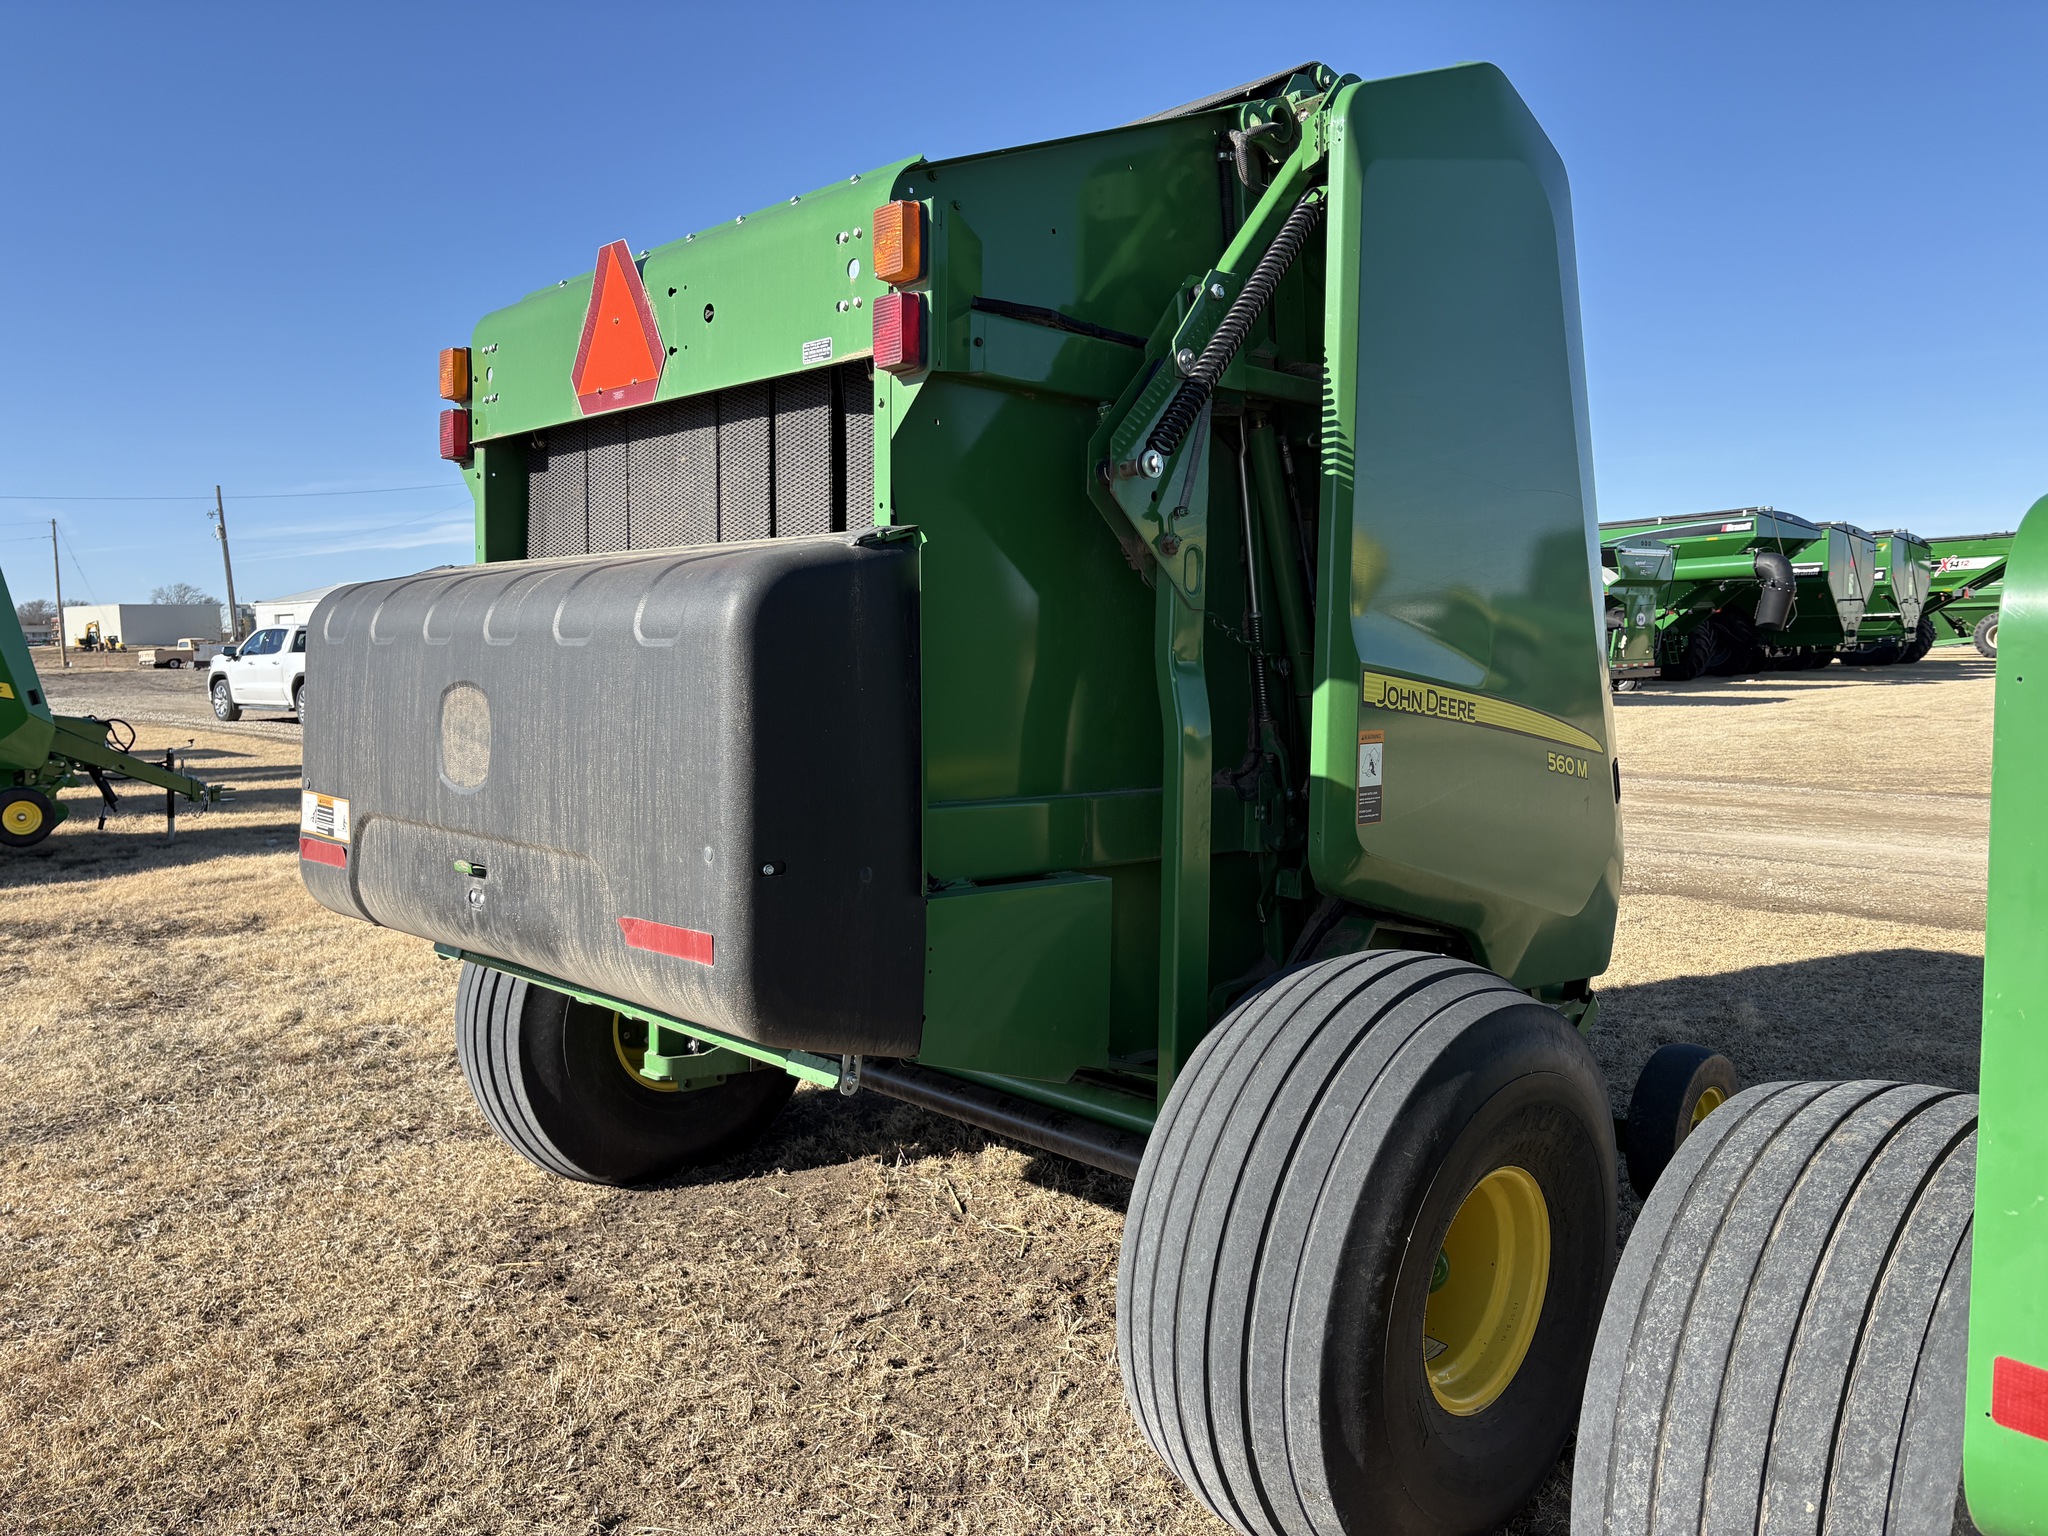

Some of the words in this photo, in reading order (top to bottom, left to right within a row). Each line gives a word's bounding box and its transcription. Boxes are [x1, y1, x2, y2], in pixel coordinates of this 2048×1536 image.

[1376, 681, 1423, 710] JOHN
[1426, 689, 1476, 721] DEERE
[1547, 751, 1575, 776] 560
[1577, 758, 1588, 780] M
